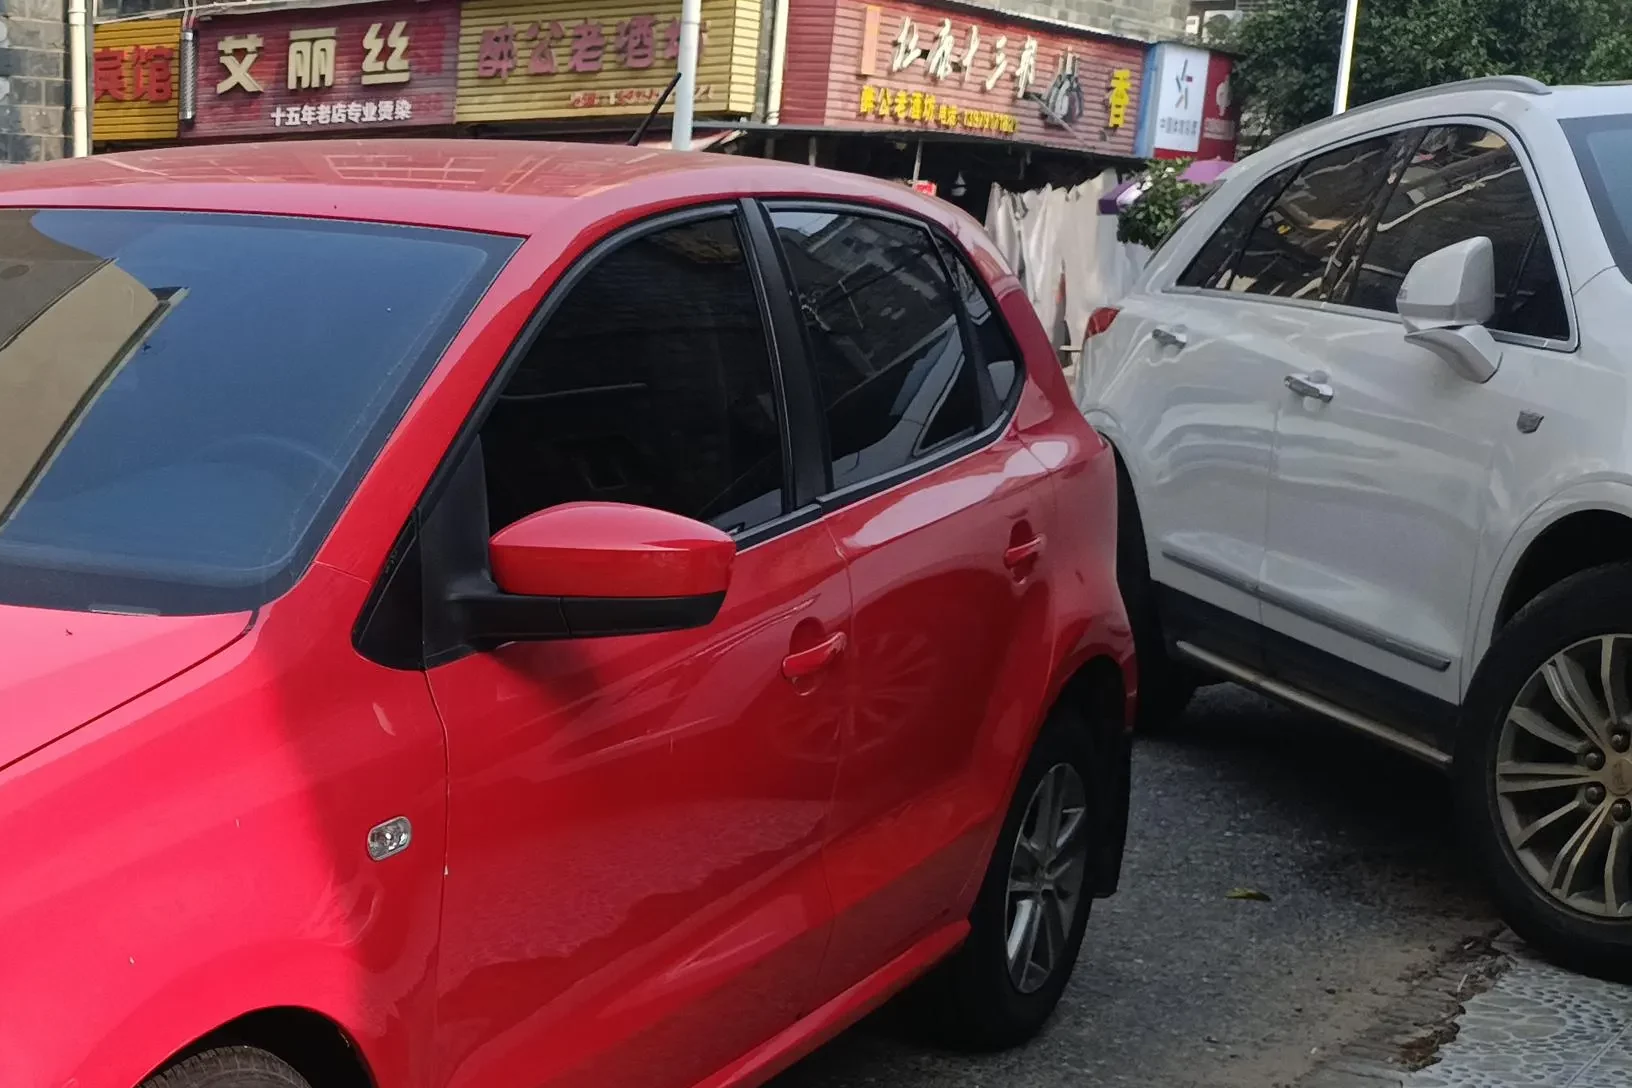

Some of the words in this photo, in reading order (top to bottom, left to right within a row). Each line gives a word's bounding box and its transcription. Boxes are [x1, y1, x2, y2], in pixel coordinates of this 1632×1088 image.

[216, 20, 410, 95] 艾丽丝
[271, 103, 412, 127] 十五年老店专业烫染
